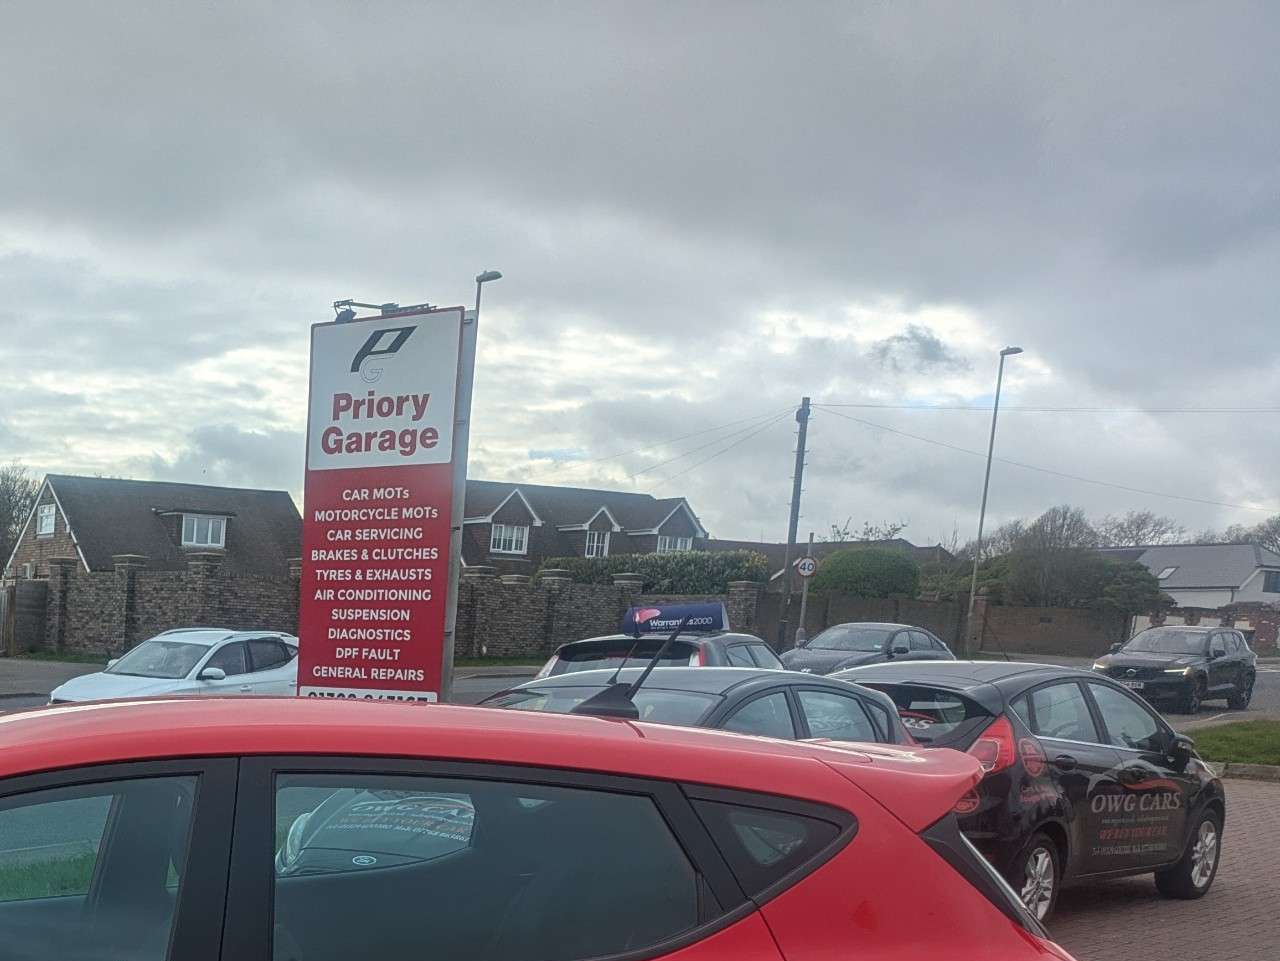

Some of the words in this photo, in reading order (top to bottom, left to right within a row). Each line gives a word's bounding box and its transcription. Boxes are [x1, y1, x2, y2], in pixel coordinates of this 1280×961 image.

[332, 391, 430, 421] Priory
[322, 426, 439, 456] Garage
[343, 489, 369, 501] CAR
[373, 487, 410, 500] MOTs
[315, 508, 398, 522] MOTORCYCLE
[402, 506, 438, 519] MOTs
[327, 530, 352, 541] CAR
[355, 528, 423, 540] SERVICING
[311, 549, 358, 561] BRAKES
[361, 549, 369, 560] &
[372, 548, 438, 560] CLUTCHES
[800, 562, 815, 571] 40
[315, 569, 351, 581] TYRES
[355, 569, 363, 580] &
[366, 568, 432, 580] EXHAUSTS
[315, 589, 334, 600] AIR
[337, 589, 431, 601] CONDITIONING
[331, 608, 410, 621] SUSPENSION
[328, 628, 411, 641] DIAGNOSTICS
[336, 647, 359, 659] DPF
[362, 648, 400, 660] FAULT
[313, 666, 368, 679] GENERAL
[371, 667, 424, 681] REPAIRS
[1091, 794, 1136, 813] OWG
[1139, 792, 1181, 811] CARS
